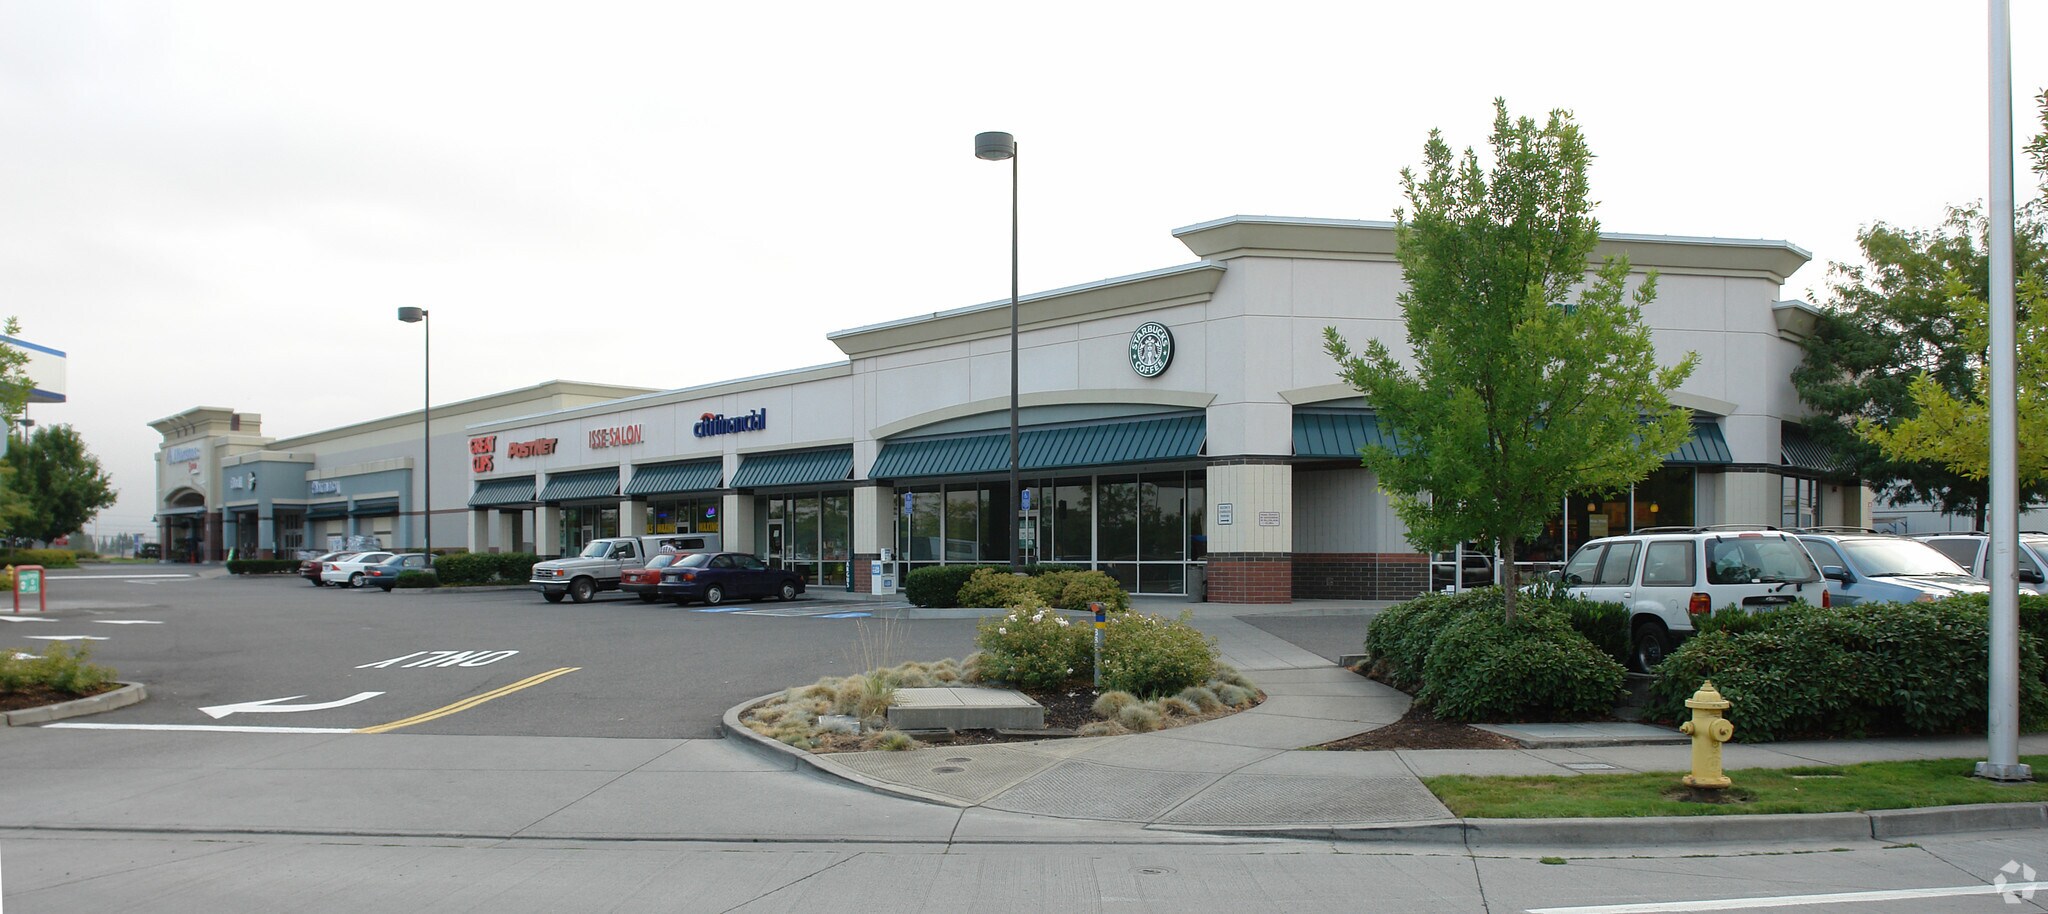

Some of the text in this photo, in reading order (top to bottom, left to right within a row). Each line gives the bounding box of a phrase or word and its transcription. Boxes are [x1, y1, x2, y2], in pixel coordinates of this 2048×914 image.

[1132, 326, 1168, 351] STARBUCKS
[1135, 358, 1164, 374] COFFEE
[609, 424, 644, 448] SALON
[354, 650, 520, 669] ONLY
